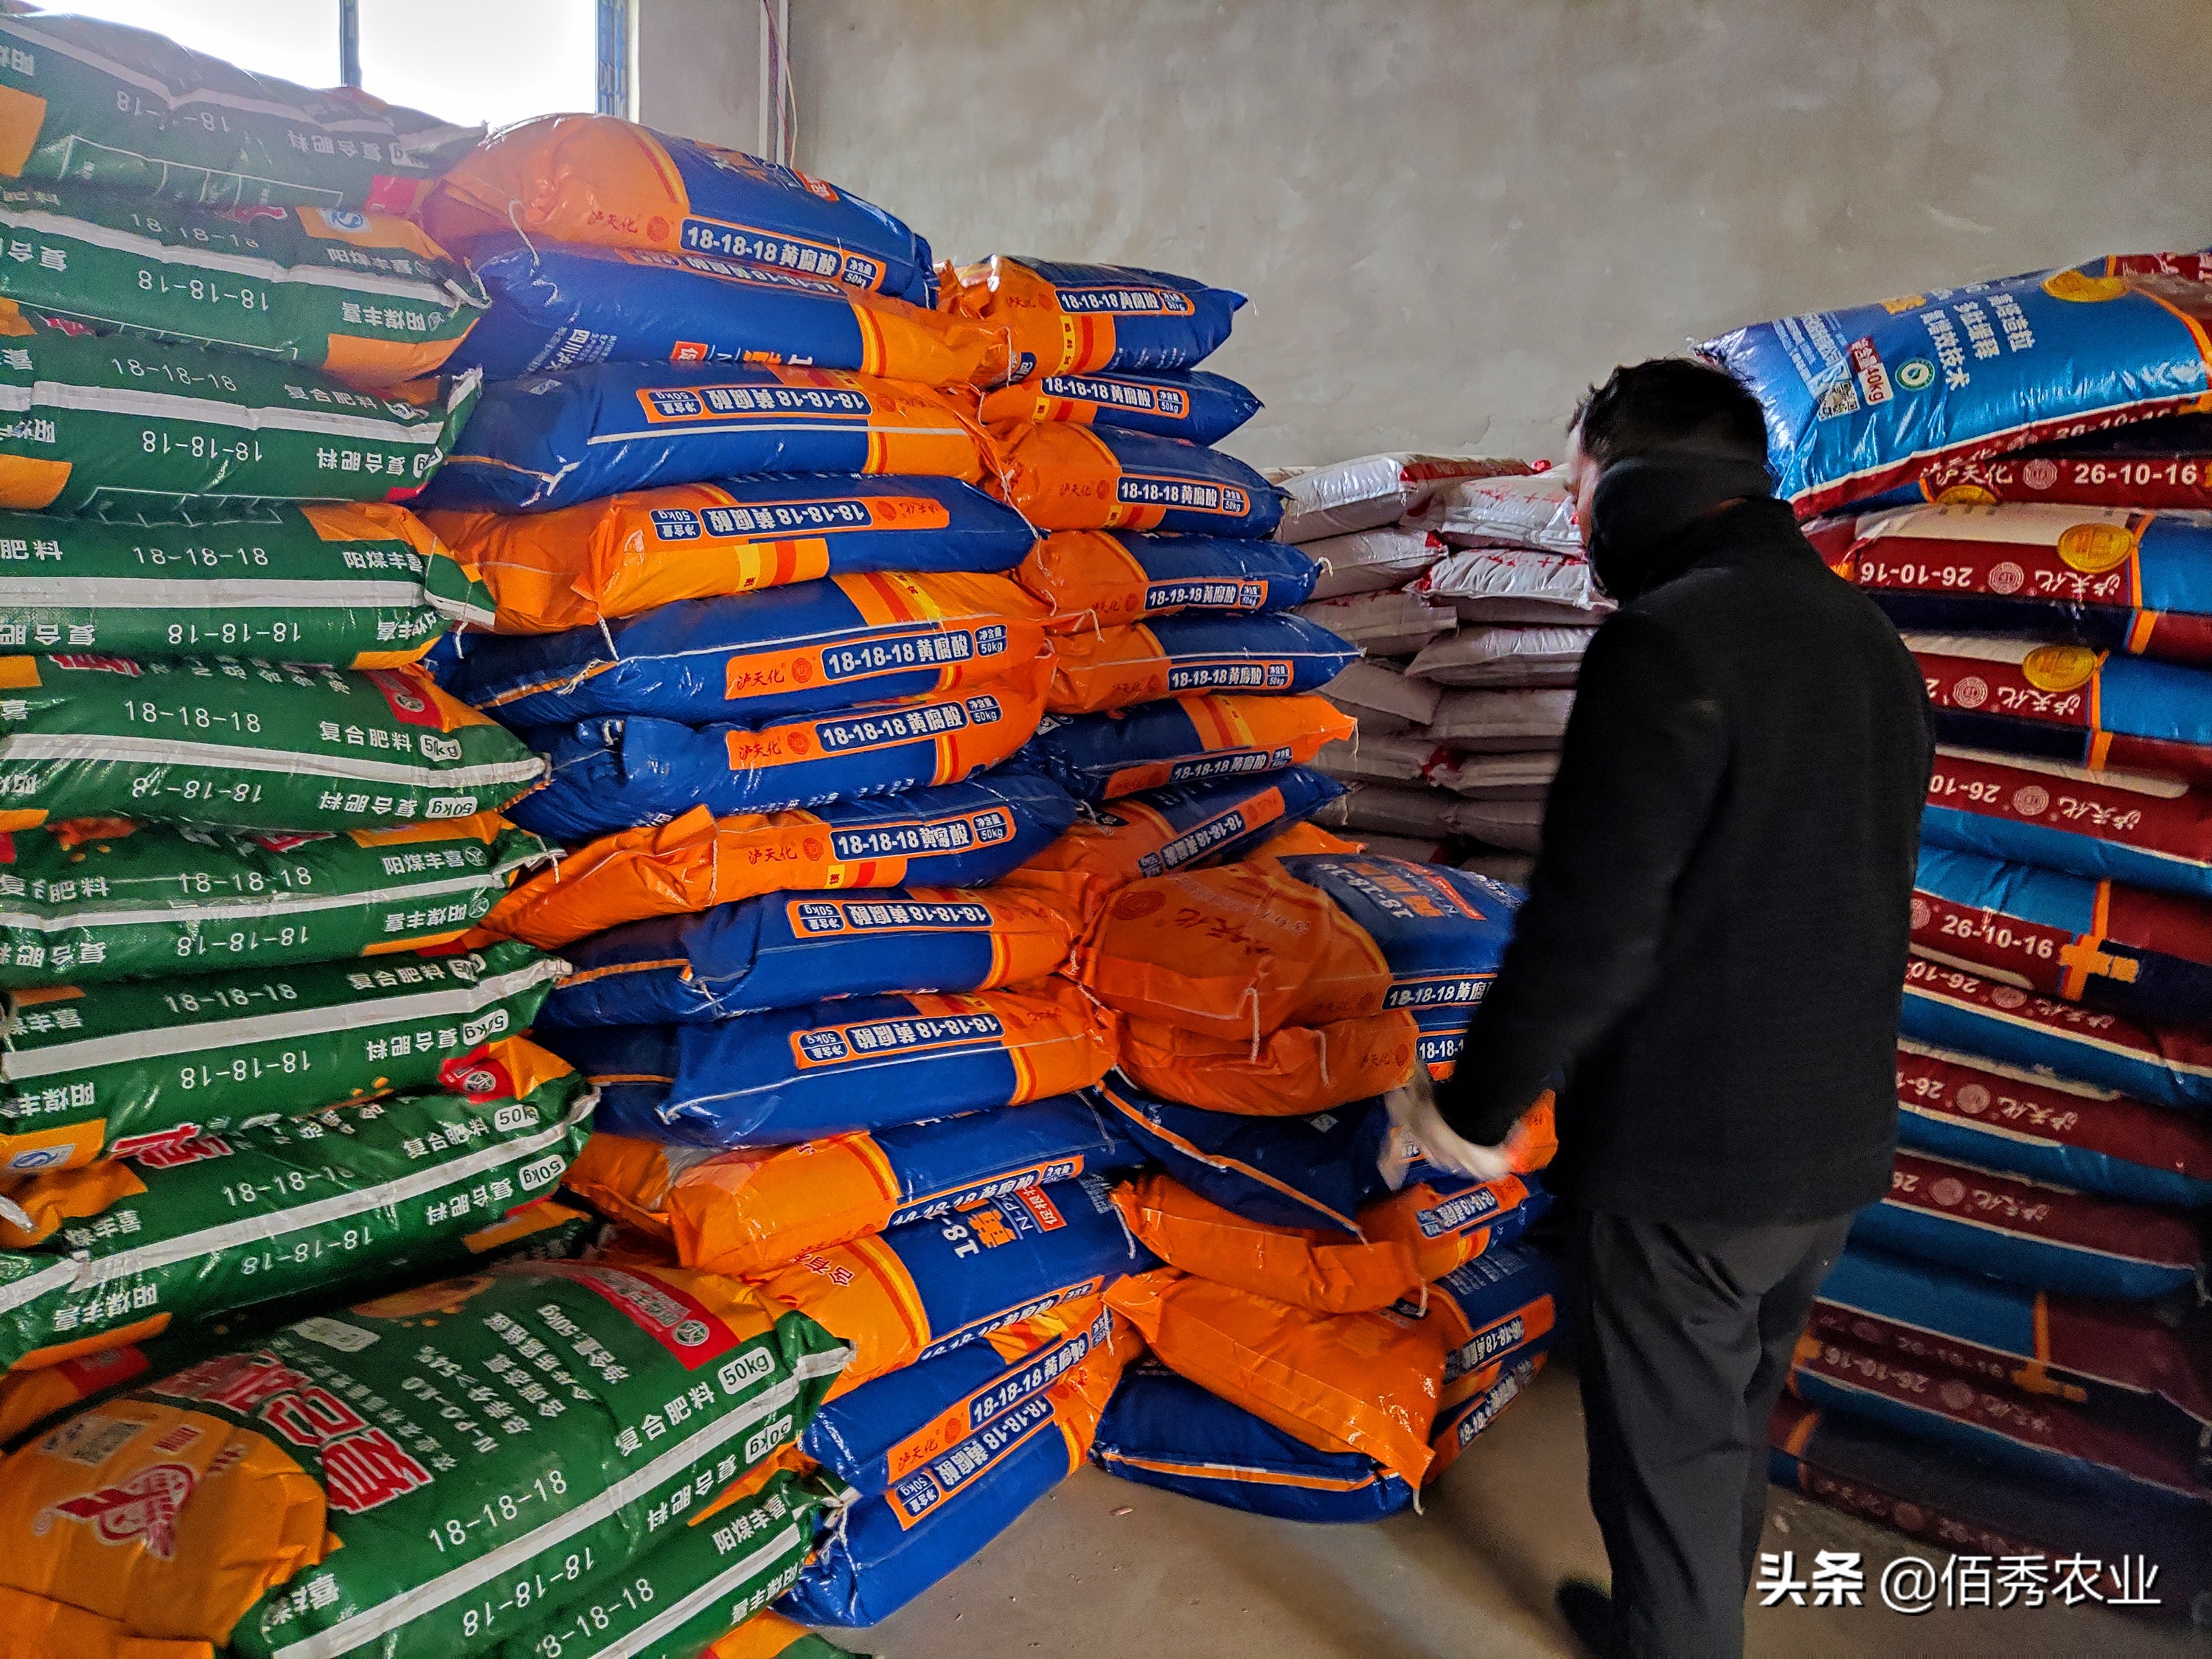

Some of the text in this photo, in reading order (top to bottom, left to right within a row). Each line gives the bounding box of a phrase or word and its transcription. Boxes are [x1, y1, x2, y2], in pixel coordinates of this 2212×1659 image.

[0, 237, 68, 272] 复合
[686, 226, 778, 262] 18-18-18
[780, 242, 838, 276] 黄腐酸
[138, 270, 269, 311] 18-18-18
[1061, 291, 1161, 311] 18-18-18 黄腐酸
[341, 301, 426, 332] 阳煤丰喜
[1986, 291, 2037, 354] 高塔造粒
[111, 358, 237, 392] 18-18-18
[285, 383, 378, 410] 复合肥料
[706, 389, 864, 410] 18-18-18 黄腐酸
[1045, 376, 1152, 408] 18-18-18 黄腐酸
[1161, 401, 1180, 414] 50kg
[142, 431, 262, 462] 18-18-18
[317, 447, 406, 476] 复合肥料
[1935, 462, 2199, 487] 泸天化 26-10-16
[1059, 483, 1092, 498] 泸天化
[1121, 481, 1218, 508] 18-18-18 黄腐酸
[658, 511, 690, 521] 50kg
[709, 503, 864, 533] 18-18-18 黄腐酸
[1225, 499, 1242, 512] 50kg
[663, 523, 696, 538] 净含量
[133, 547, 269, 566] 18-18-18
[342, 550, 424, 573] 阳煤丰喜
[1860, 562, 2121, 597] 泸天化 26-10-16
[1150, 585, 1236, 607] 18-18-18 黄腐酸
[167, 622, 302, 645] 18-18-18
[978, 627, 1004, 641] 净含量
[828, 636, 971, 675] 18-18-18 黄腐酸
[981, 641, 1004, 655] 50kg
[737, 667, 785, 691] 泸天化
[1172, 667, 1262, 687] 18-18-18 黄腐酸
[1269, 665, 1287, 675] 净含量
[1269, 676, 1286, 686] 50kg
[968, 698, 994, 710] 净含量
[1998, 686, 2081, 715] 泸天化
[125, 700, 262, 734] 18-18-18
[822, 707, 964, 749] 18-18-18 黄腐酸
[974, 710, 998, 723] 50kg
[319, 720, 413, 753] 复合肥料
[738, 742, 783, 762] 泸天化
[1175, 754, 1267, 779] 18-18-18 黄腐酸
[131, 776, 263, 804] 18-18-18
[320, 790, 473, 818] 复合肥料 50kg
[975, 814, 1001, 828] 净含量
[2059, 796, 2142, 831] 泸天化
[838, 823, 970, 855] 18-18-18 黄腐酸
[981, 827, 1004, 841] 50kg
[1197, 813, 1242, 849] 18-18-18
[381, 849, 465, 876] 阳煤丰喜
[748, 846, 799, 866] 泸天化
[384, 905, 468, 933] 阳煤丰喜
[804, 904, 834, 917] 50kg
[810, 918, 841, 931] 净含量
[848, 905, 986, 925] 18-18-18 黄腐酸
[177, 926, 309, 957] 18-18-18
[1941, 914, 2054, 959] 26-10-16
[346, 963, 447, 990] 复合肥料
[163, 984, 298, 1014] 18-18-18
[1389, 985, 1455, 1006] 18-18-18
[366, 1029, 458, 1061] 复合肥料
[805, 1031, 837, 1045] 50kg
[855, 1016, 998, 1051] 18-18-18 黄腐酸
[813, 1043, 845, 1060] 净含量
[181, 1050, 311, 1090] 18-18-18
[1997, 1096, 2079, 1132] 泸天化
[426, 1159, 564, 1226] 复合肥料 50kg
[240, 1226, 374, 1275] 18-18-18
[973, 1339, 1086, 1425] 18-18-18 黄腐酸
[614, 1354, 771, 1458] 复合肥料 50kg
[898, 1439, 939, 1468] 泸天化
[936, 1398, 1048, 1486] 18-18-18 黄腐酸
[647, 1453, 737, 1532] 复合肥料
[900, 1473, 928, 1497] 50kg
[428, 1470, 567, 1553] 18-18-18
[712, 1492, 787, 1555] 阳煤丰喜
[463, 1547, 594, 1637] 18-18-18
[731, 1565, 798, 1624] 阳煤丰喜
